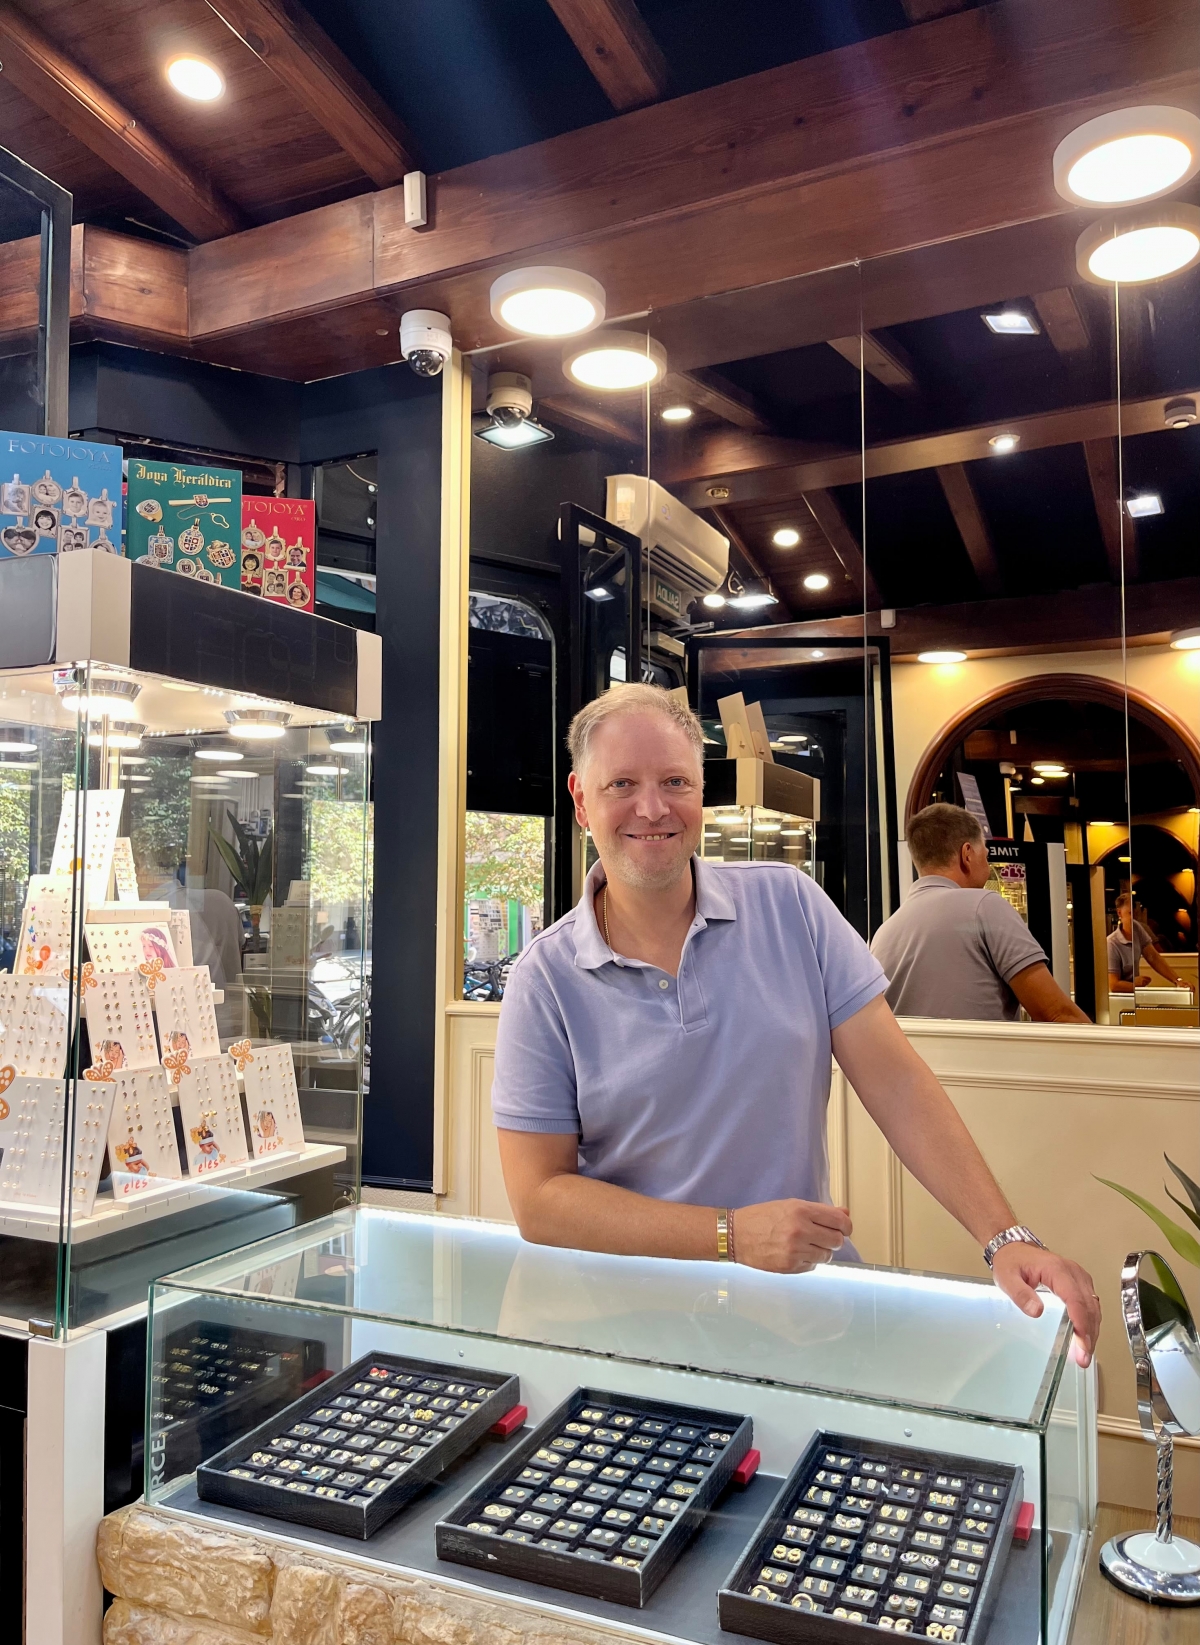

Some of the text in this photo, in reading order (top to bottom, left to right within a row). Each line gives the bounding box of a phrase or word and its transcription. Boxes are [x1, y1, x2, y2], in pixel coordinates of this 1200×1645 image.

[8, 439, 111, 463] FOTOJOYA
[134, 463, 232, 488] Joya Heráldica
[258, 1139, 277, 1154] eles
[198, 1156, 219, 1173] eles
[124, 1176, 148, 1193] eles
